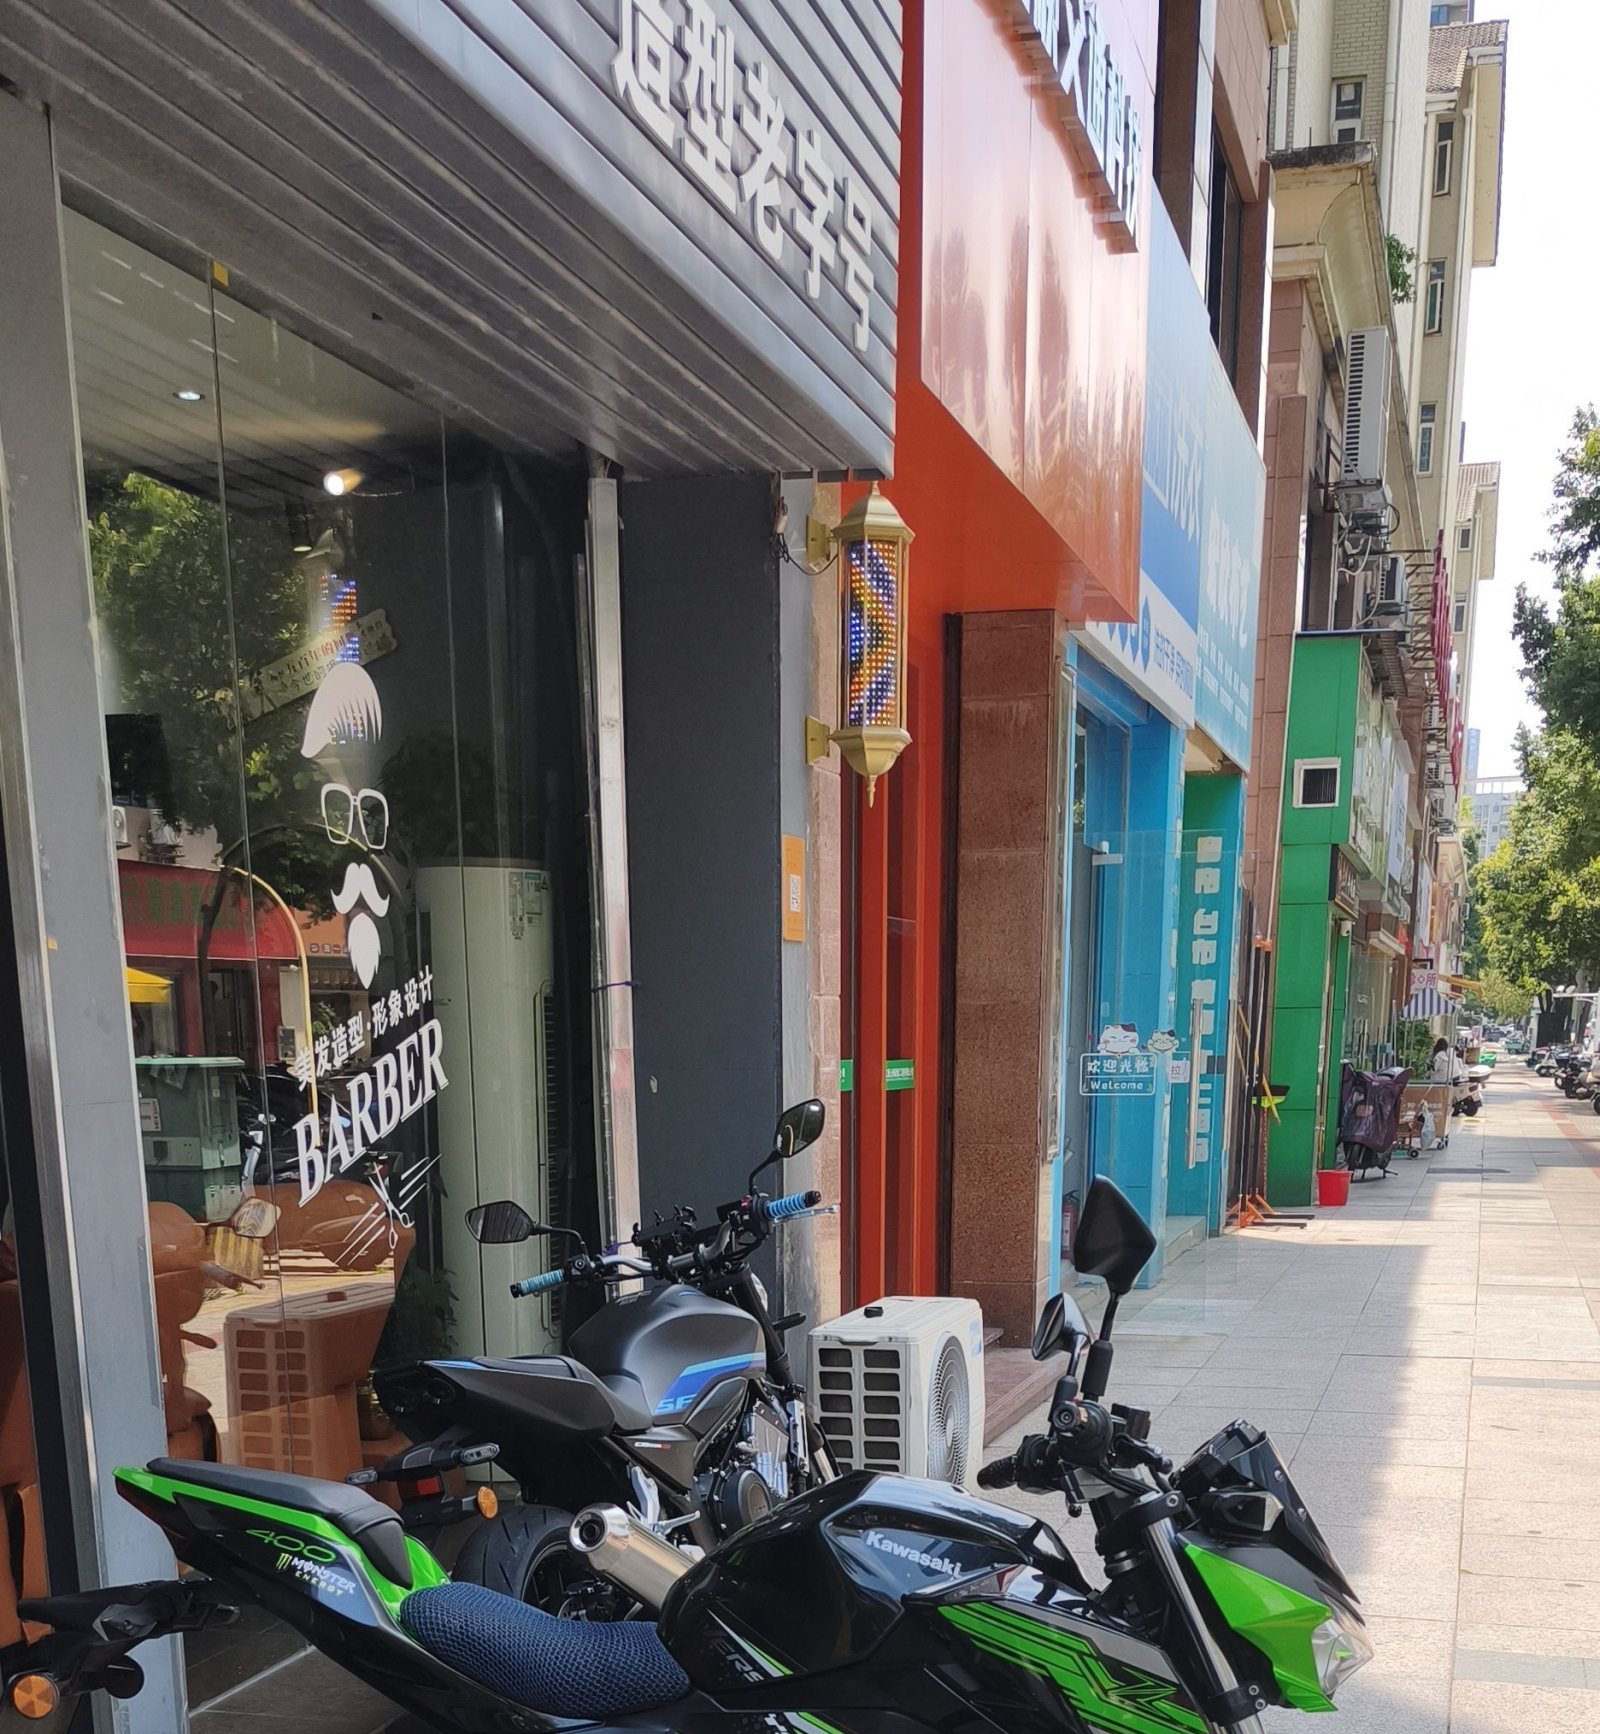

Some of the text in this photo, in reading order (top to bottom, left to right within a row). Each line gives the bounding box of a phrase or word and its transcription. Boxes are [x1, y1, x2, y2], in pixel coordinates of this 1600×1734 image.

[1087, 1058, 1149, 1073] 欢迎光临
[1090, 1080, 1144, 1090] Welcome
[292, 1018, 450, 1208] BARBER
[245, 1528, 336, 1562] 400
[865, 1530, 963, 1579] Kawasaki
[291, 1556, 357, 1594] MONSTER
[295, 1571, 344, 1596] ENERGY
